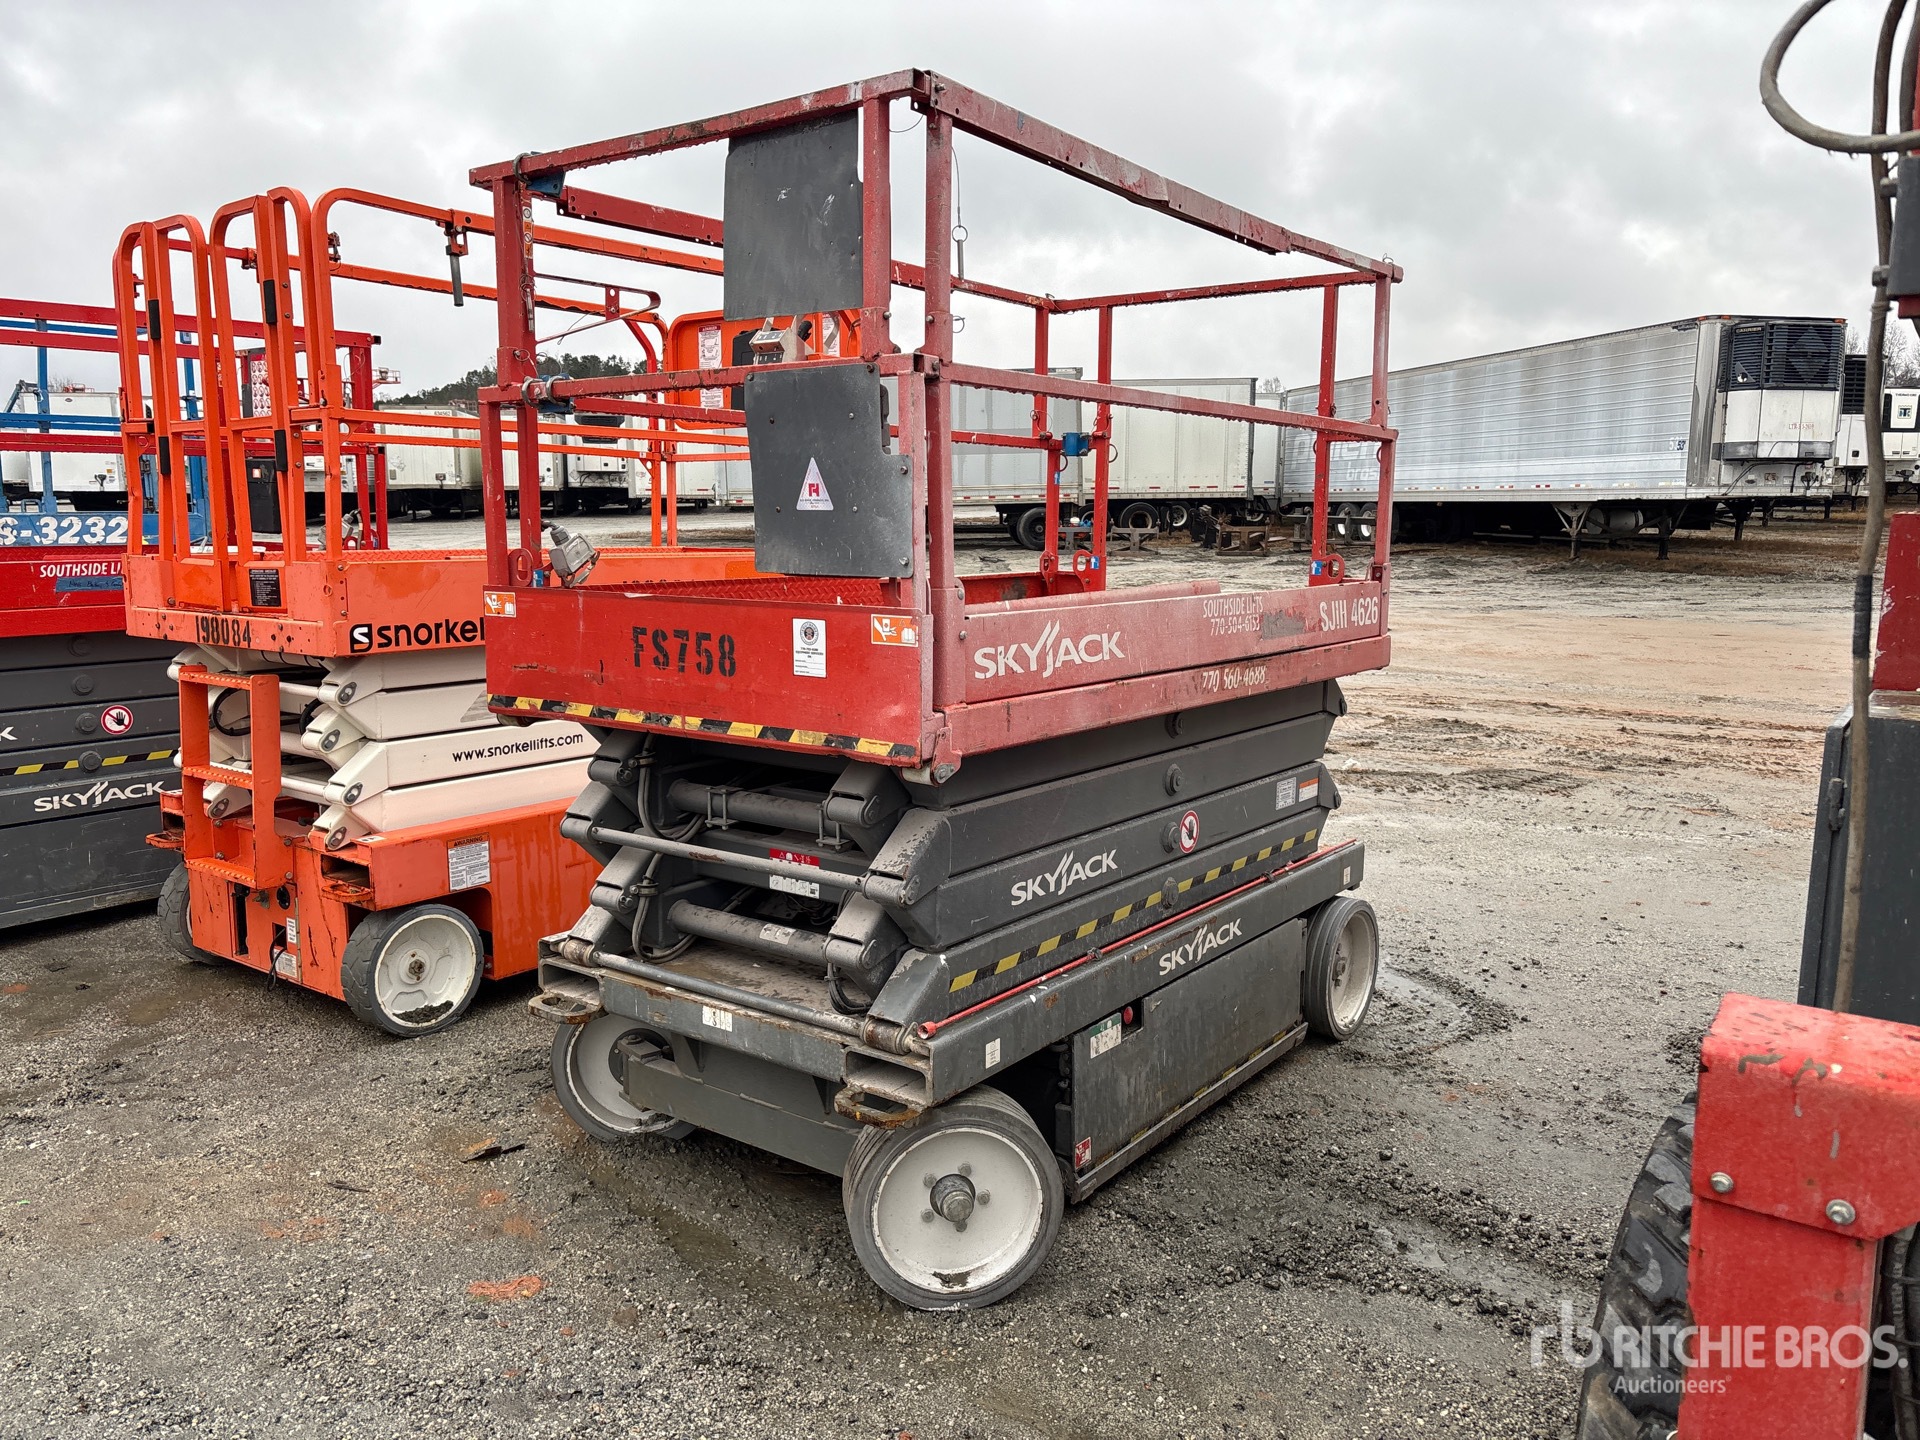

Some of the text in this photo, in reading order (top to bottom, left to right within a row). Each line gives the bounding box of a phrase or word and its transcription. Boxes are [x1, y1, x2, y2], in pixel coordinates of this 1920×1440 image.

[40, 562, 108, 578] SOUTHSIDE
[1202, 595, 1264, 619] SOUTHSIDE LIFTS
[1351, 596, 1379, 627] 4626
[195, 615, 252, 649] 198084
[632, 625, 737, 678] FS758
[974, 619, 1125, 679] SKYJACK
[1202, 669, 1220, 693] 770
[452, 733, 584, 762] www.snorkellifts.com
[33, 780, 166, 812] SKYJACK
[1010, 849, 1118, 906] SKYJACK
[1158, 918, 1243, 976] SKYJACK
